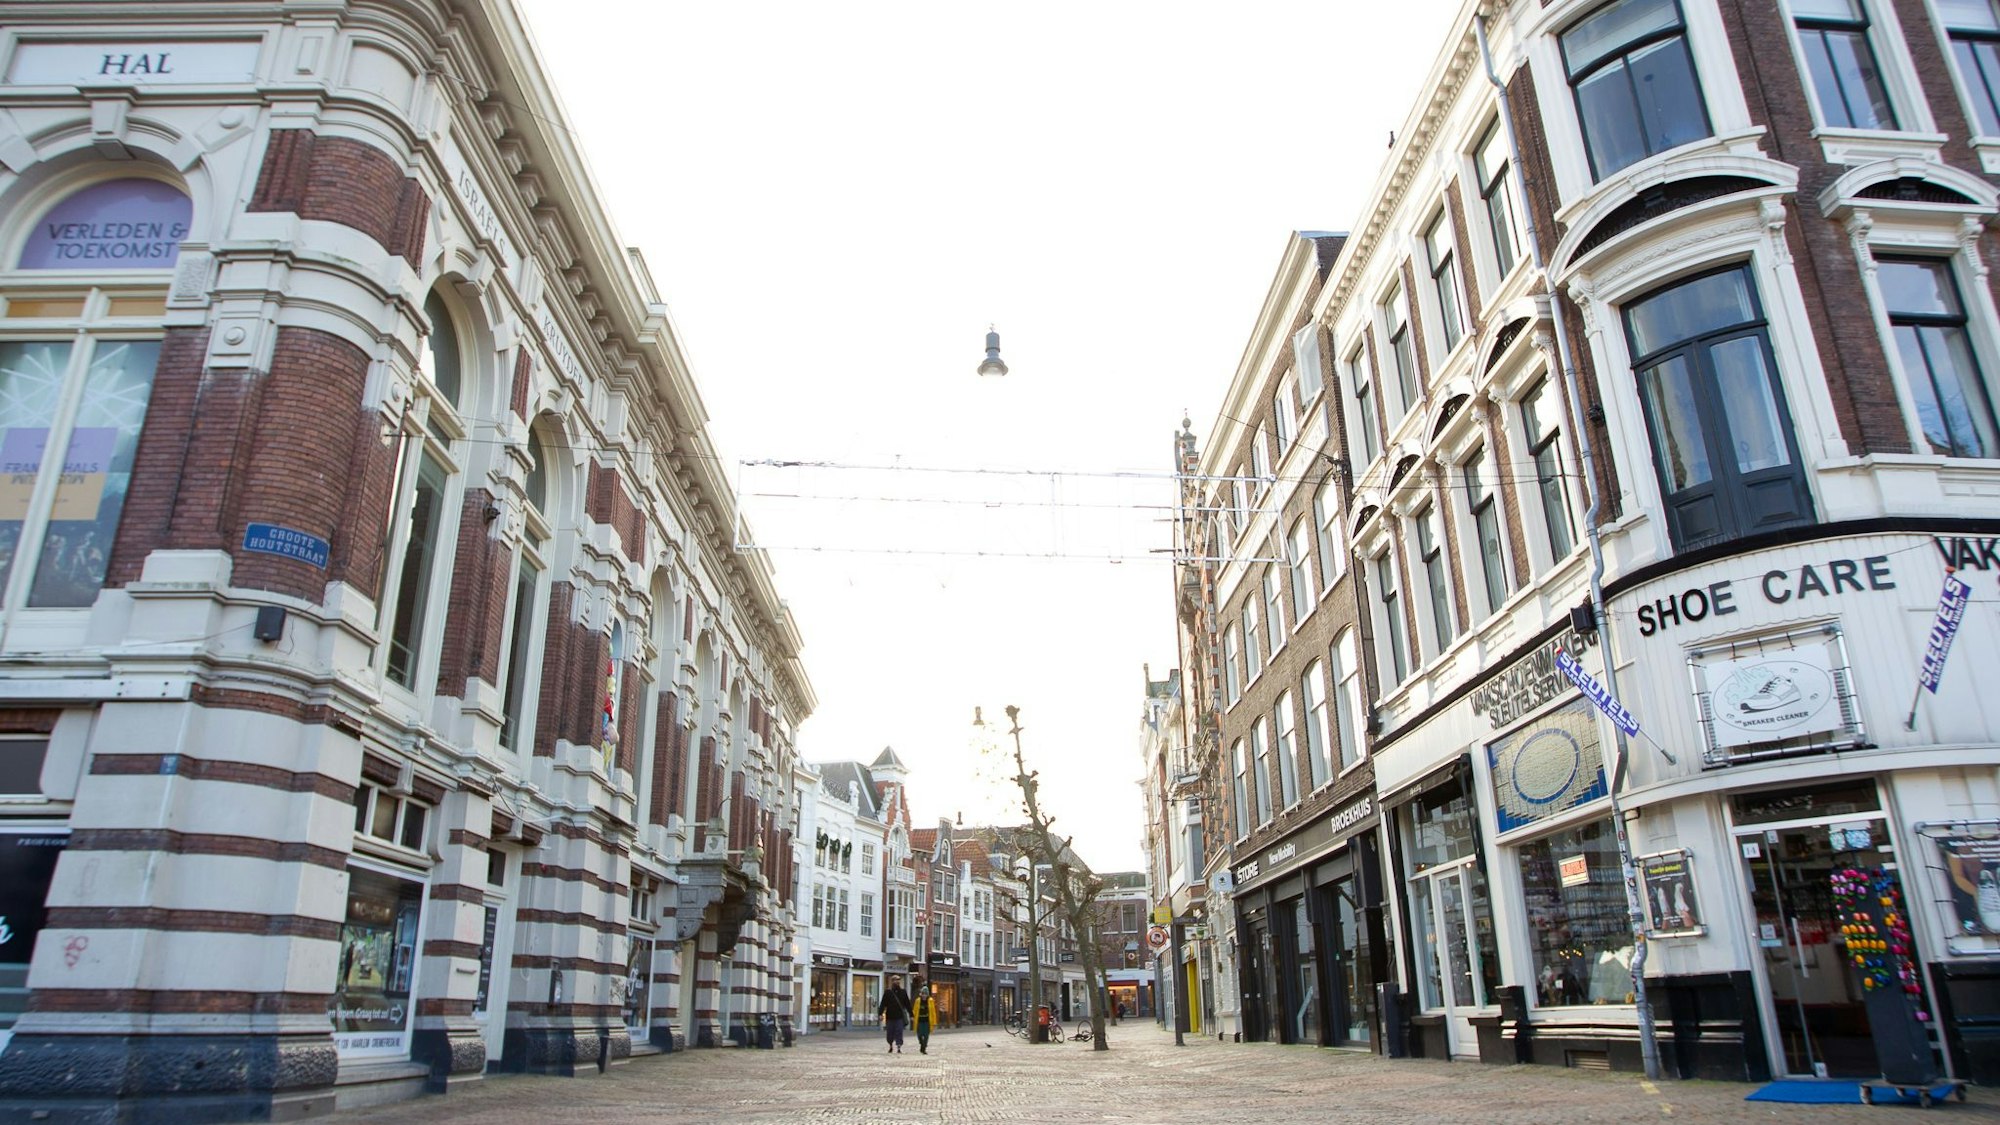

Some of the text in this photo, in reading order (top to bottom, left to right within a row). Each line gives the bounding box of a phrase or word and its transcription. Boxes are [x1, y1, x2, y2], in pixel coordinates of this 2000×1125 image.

[99, 52, 173, 75] HAL
[49, 222, 187, 239] VERLEDEN &
[55, 241, 178, 259] TOEKOMST
[250, 537, 324, 564] HOUTSTRAAT
[269, 528, 316, 549] GROOTE
[1935, 536, 2000, 570] VAK
[1637, 555, 1896, 637] SHOE CARE
[1920, 578, 1962, 687] SLEUTELS
[1560, 651, 1639, 731] SLEUTELS
[1606, 709, 1628, 730] WACHT
[1743, 716, 1776, 728] SNEAKER
[1776, 711, 1809, 723] CLEANER
[1331, 798, 1371, 834] BROEKHUIS
